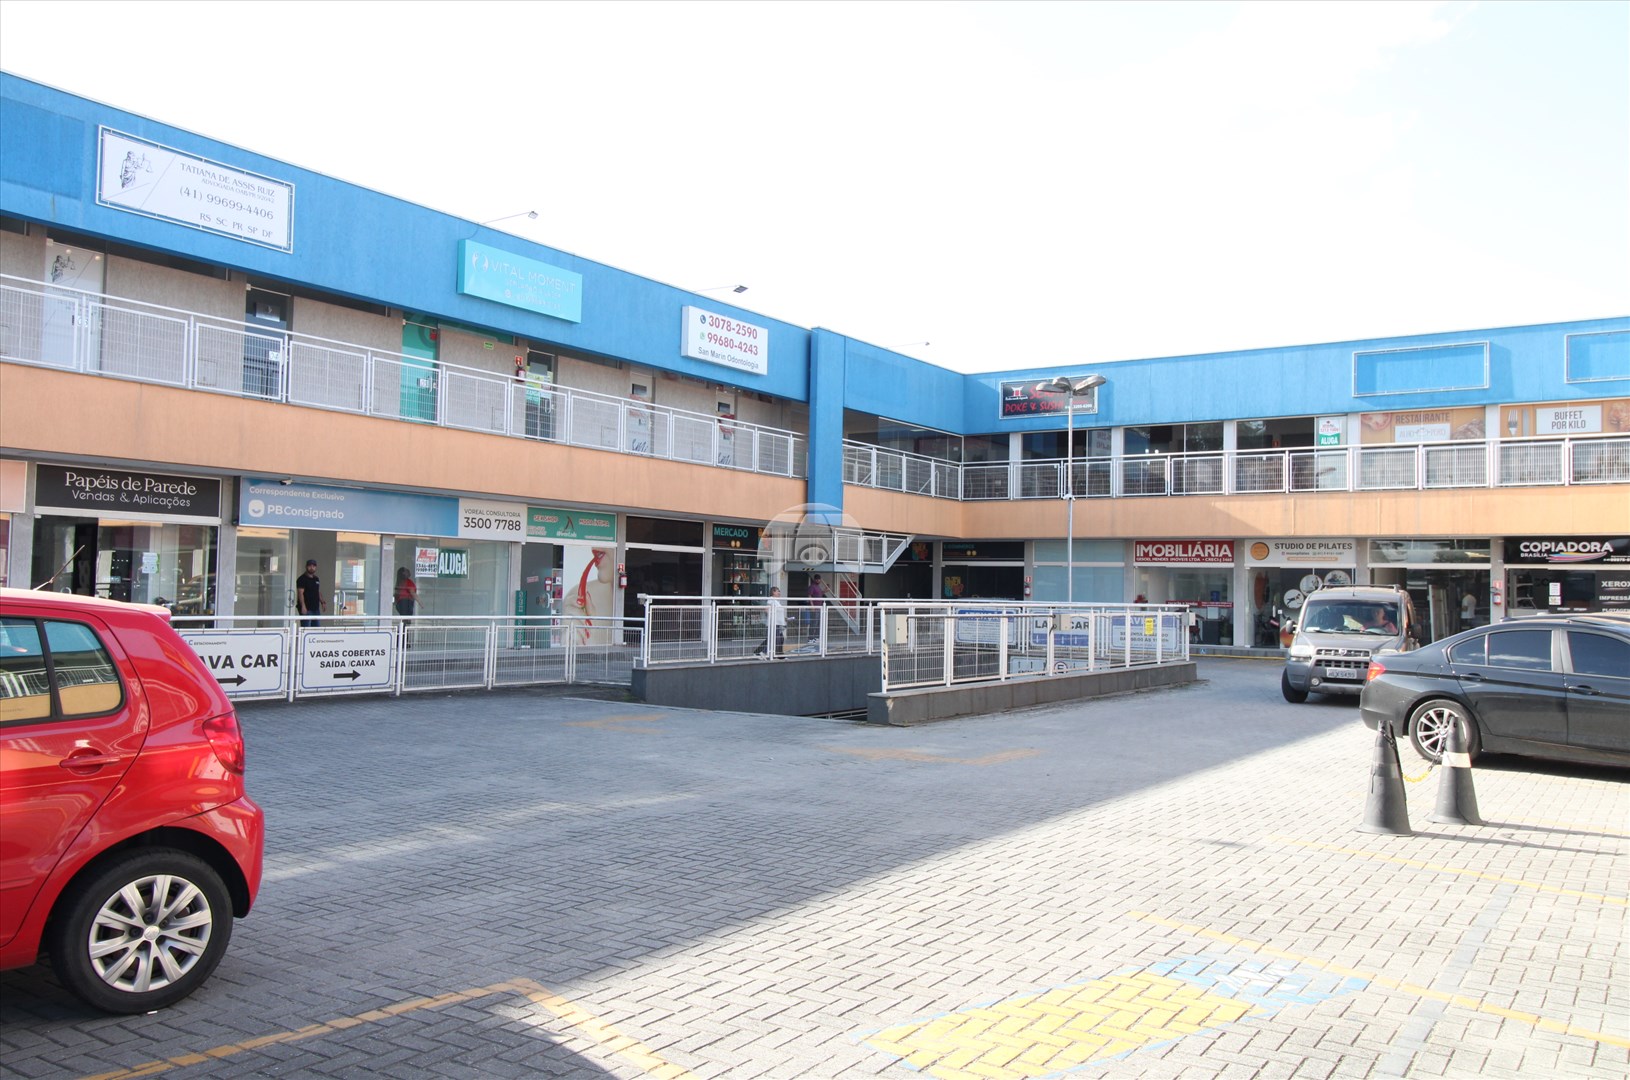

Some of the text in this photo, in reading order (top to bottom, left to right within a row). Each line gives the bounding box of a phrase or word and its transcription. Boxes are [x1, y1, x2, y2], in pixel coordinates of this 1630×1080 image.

[180, 162, 275, 197] TATIANA DE ASSIS RUIZ
[180, 185, 274, 220] (41) 99699-4406
[200, 212, 212, 223] RS
[216, 216, 228, 227] SC
[232, 220, 243, 231] PR
[247, 224, 258, 234] SP
[492, 262, 525, 280] VITAL
[528, 272, 577, 293] MOMENT
[708, 315, 758, 340] 3078-2590
[707, 332, 759, 356] 99680-4243
[698, 346, 710, 356] San
[710, 350, 726, 360] Marin
[1005, 402, 1027, 413] POKE
[1040, 400, 1064, 411] SUSHI
[1396, 412, 1450, 424] RESTAURANTE
[1554, 410, 1583, 420] BUFFET
[1552, 420, 1586, 430] POR KILO
[1320, 436, 1338, 445] ALUGA
[65, 472, 198, 496] Papéis de Parede
[72, 490, 191, 509] Vendas & Aplicações
[250, 486, 344, 501] Correspondente Exclusivo
[464, 508, 521, 518] VOREAL CONSULTORIA
[464, 516, 492, 530] 3500
[494, 519, 521, 531] 7788
[714, 526, 748, 538] MERCADO
[1136, 542, 1232, 557] IMOBILIÁRIA
[1318, 542, 1352, 550] PILATES
[1520, 542, 1614, 552] COPIADORA
[438, 552, 468, 575] ALUGA
[310, 648, 386, 658] VAGAS COBERTAS
[240, 654, 278, 668] CAR
[320, 659, 346, 668] SAÍDA
